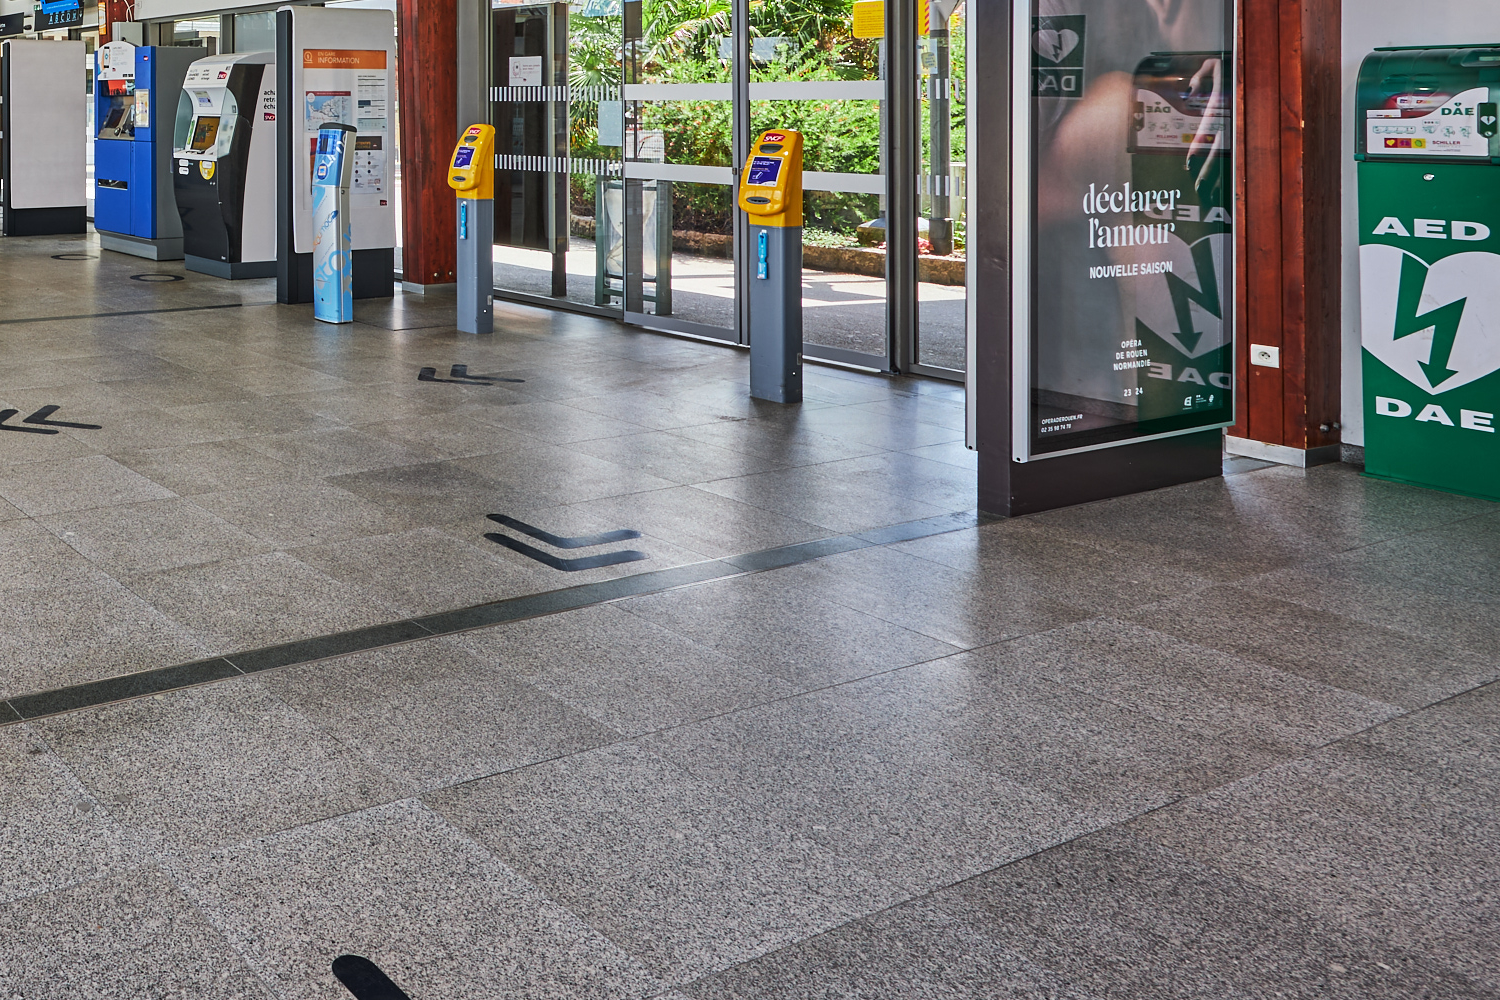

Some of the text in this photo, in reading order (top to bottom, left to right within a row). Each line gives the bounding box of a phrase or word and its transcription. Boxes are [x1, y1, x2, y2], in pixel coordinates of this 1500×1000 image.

[1441, 107, 1474, 116] DAE
[1082, 181, 1181, 214] déclarer
[1088, 217, 1176, 249] l'amour
[1372, 216, 1491, 241] AED
[1089, 260, 1173, 279] NOUVELLE SAISON
[1121, 339, 1142, 349] OPÉRA
[1115, 349, 1148, 361] DE ROUEN
[1113, 359, 1151, 371] NORMANDIE
[1123, 387, 1144, 397] 23 24
[1375, 395, 1495, 433] DAE
